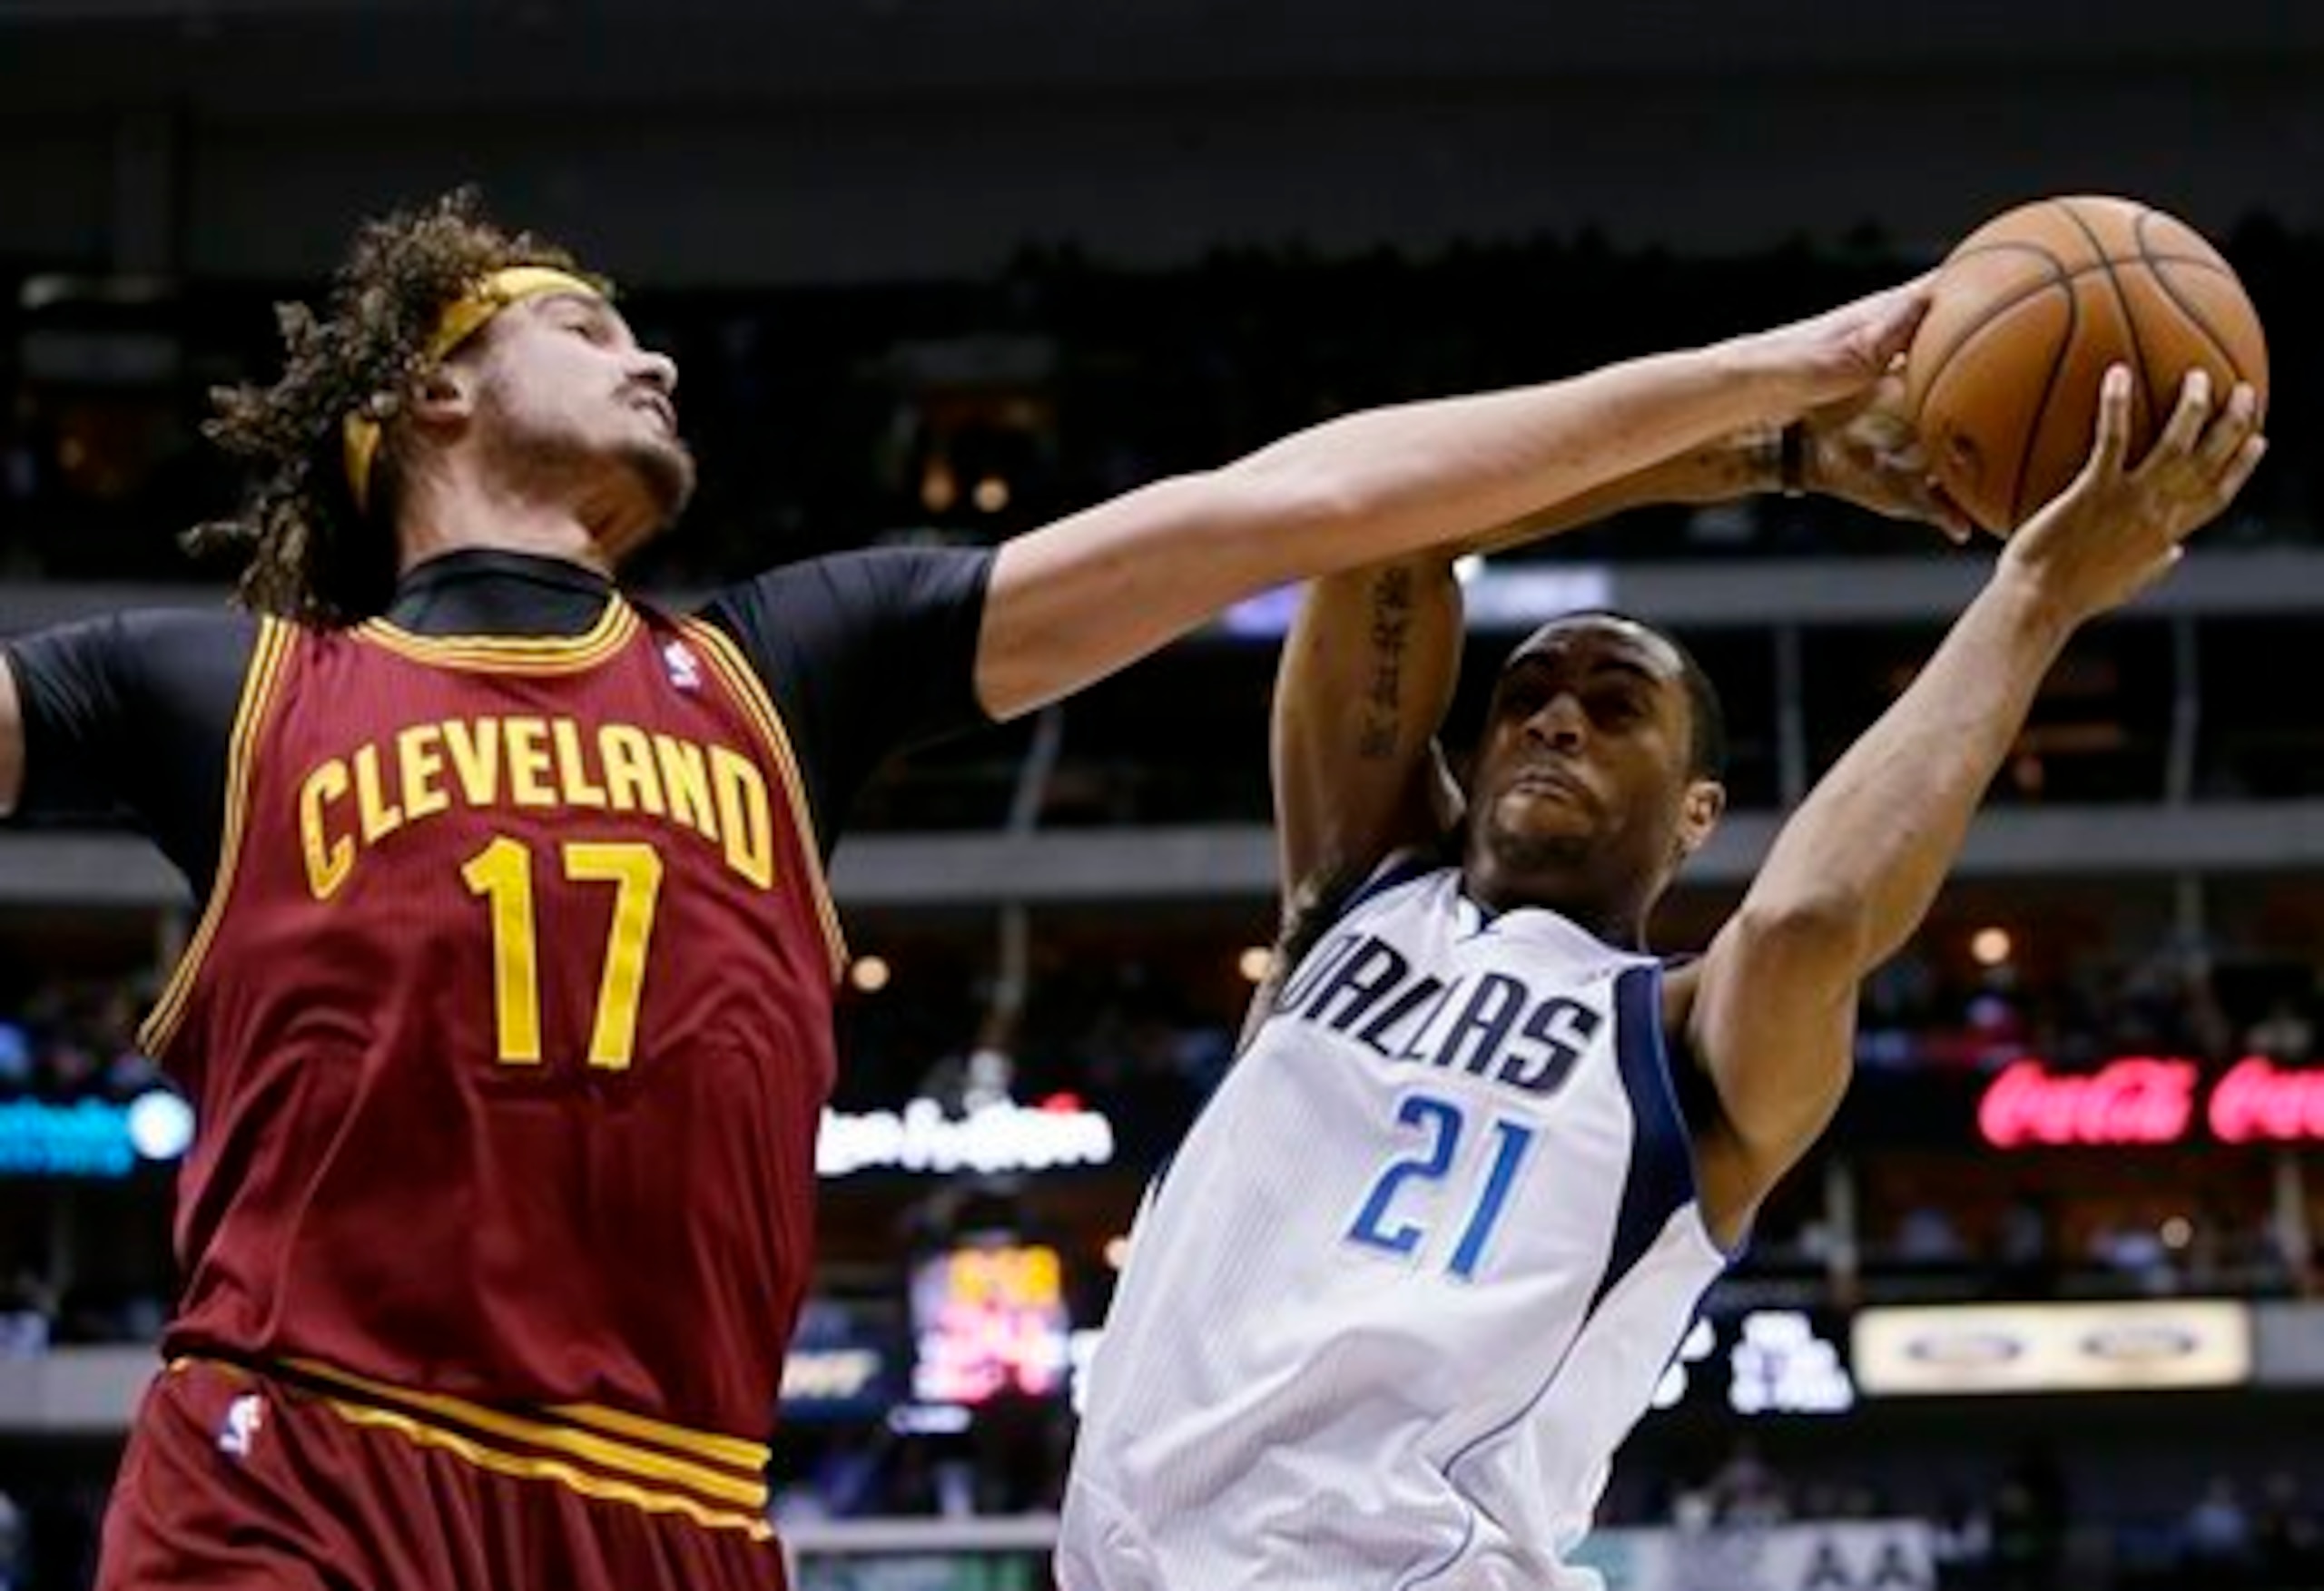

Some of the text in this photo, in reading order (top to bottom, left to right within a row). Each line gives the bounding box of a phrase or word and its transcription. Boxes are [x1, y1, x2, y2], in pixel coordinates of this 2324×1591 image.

[300, 717, 773, 899] CLEVELAND
[461, 837, 663, 1068] 17
[1344, 1095, 1534, 1282] 21
